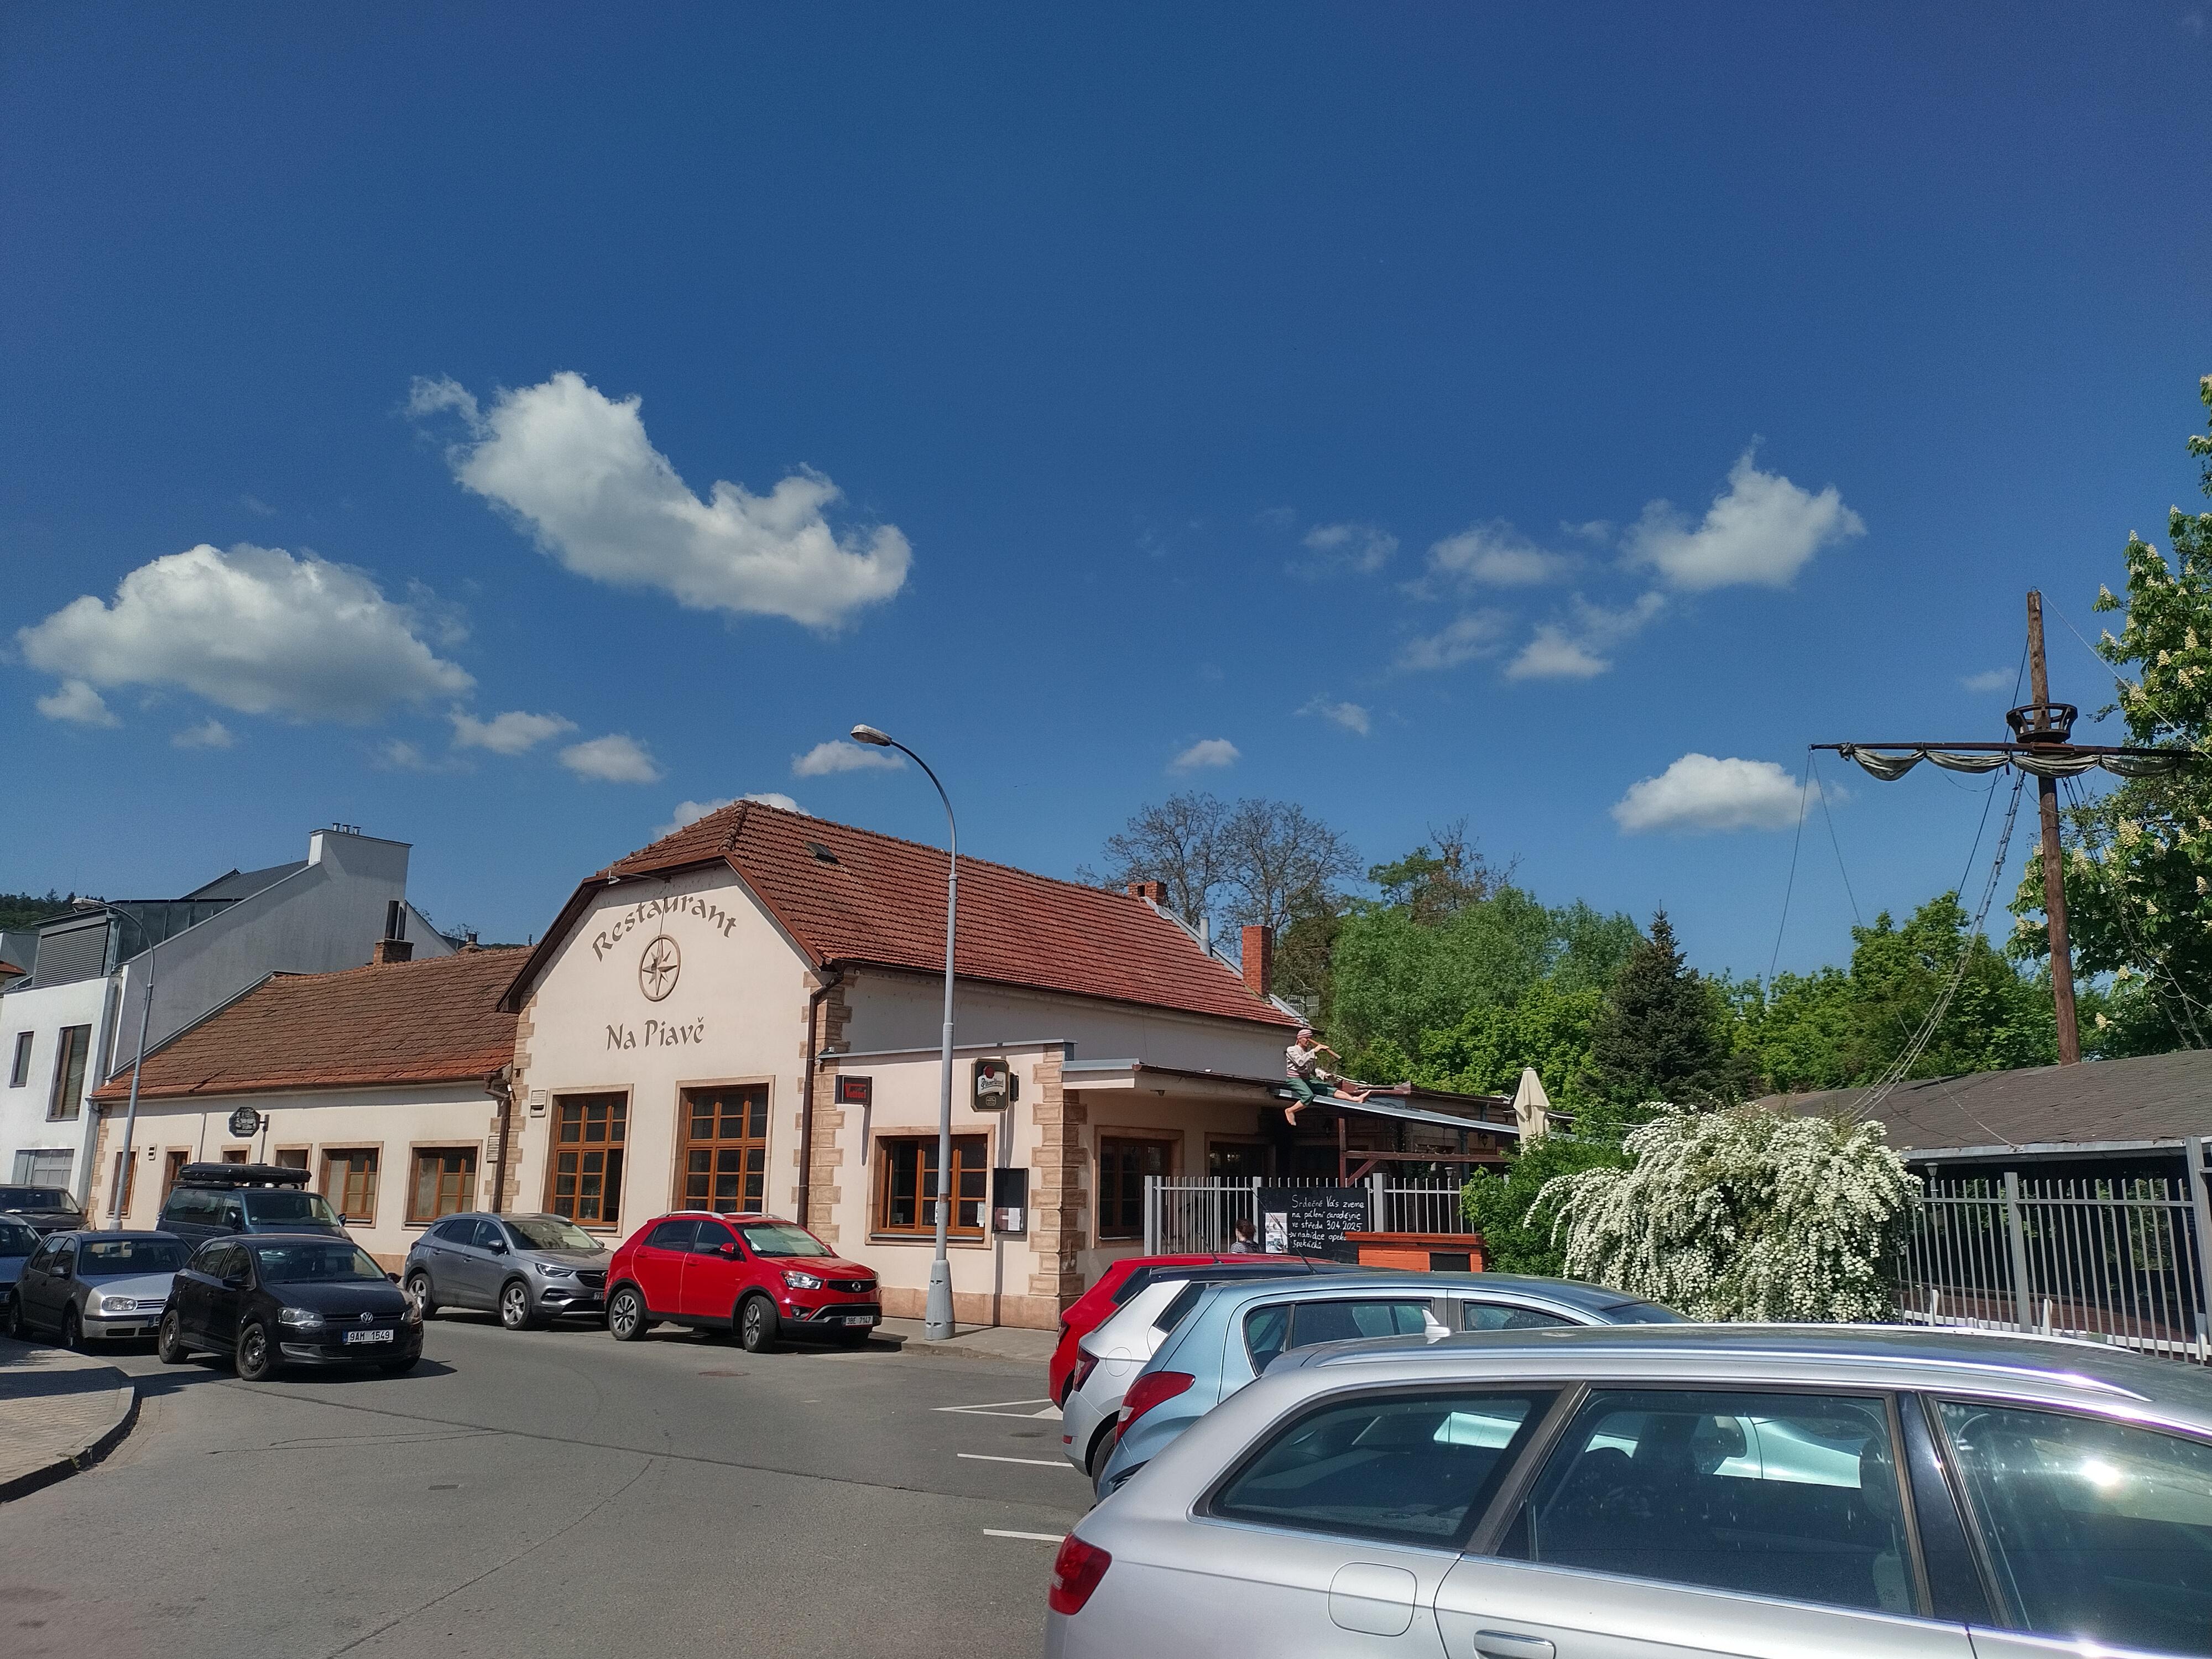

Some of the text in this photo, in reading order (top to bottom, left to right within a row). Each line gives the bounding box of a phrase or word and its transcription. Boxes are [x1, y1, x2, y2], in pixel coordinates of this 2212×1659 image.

[592, 895, 737, 963] Restaurant
[606, 1016, 705, 1051] Na Piavě
[1326, 1195, 1339, 1207] Vás
[1305, 1208, 1326, 1219] pálení
[1297, 1229, 1325, 1240] nabídce
[350, 1331, 390, 1341] 9AM 1549
